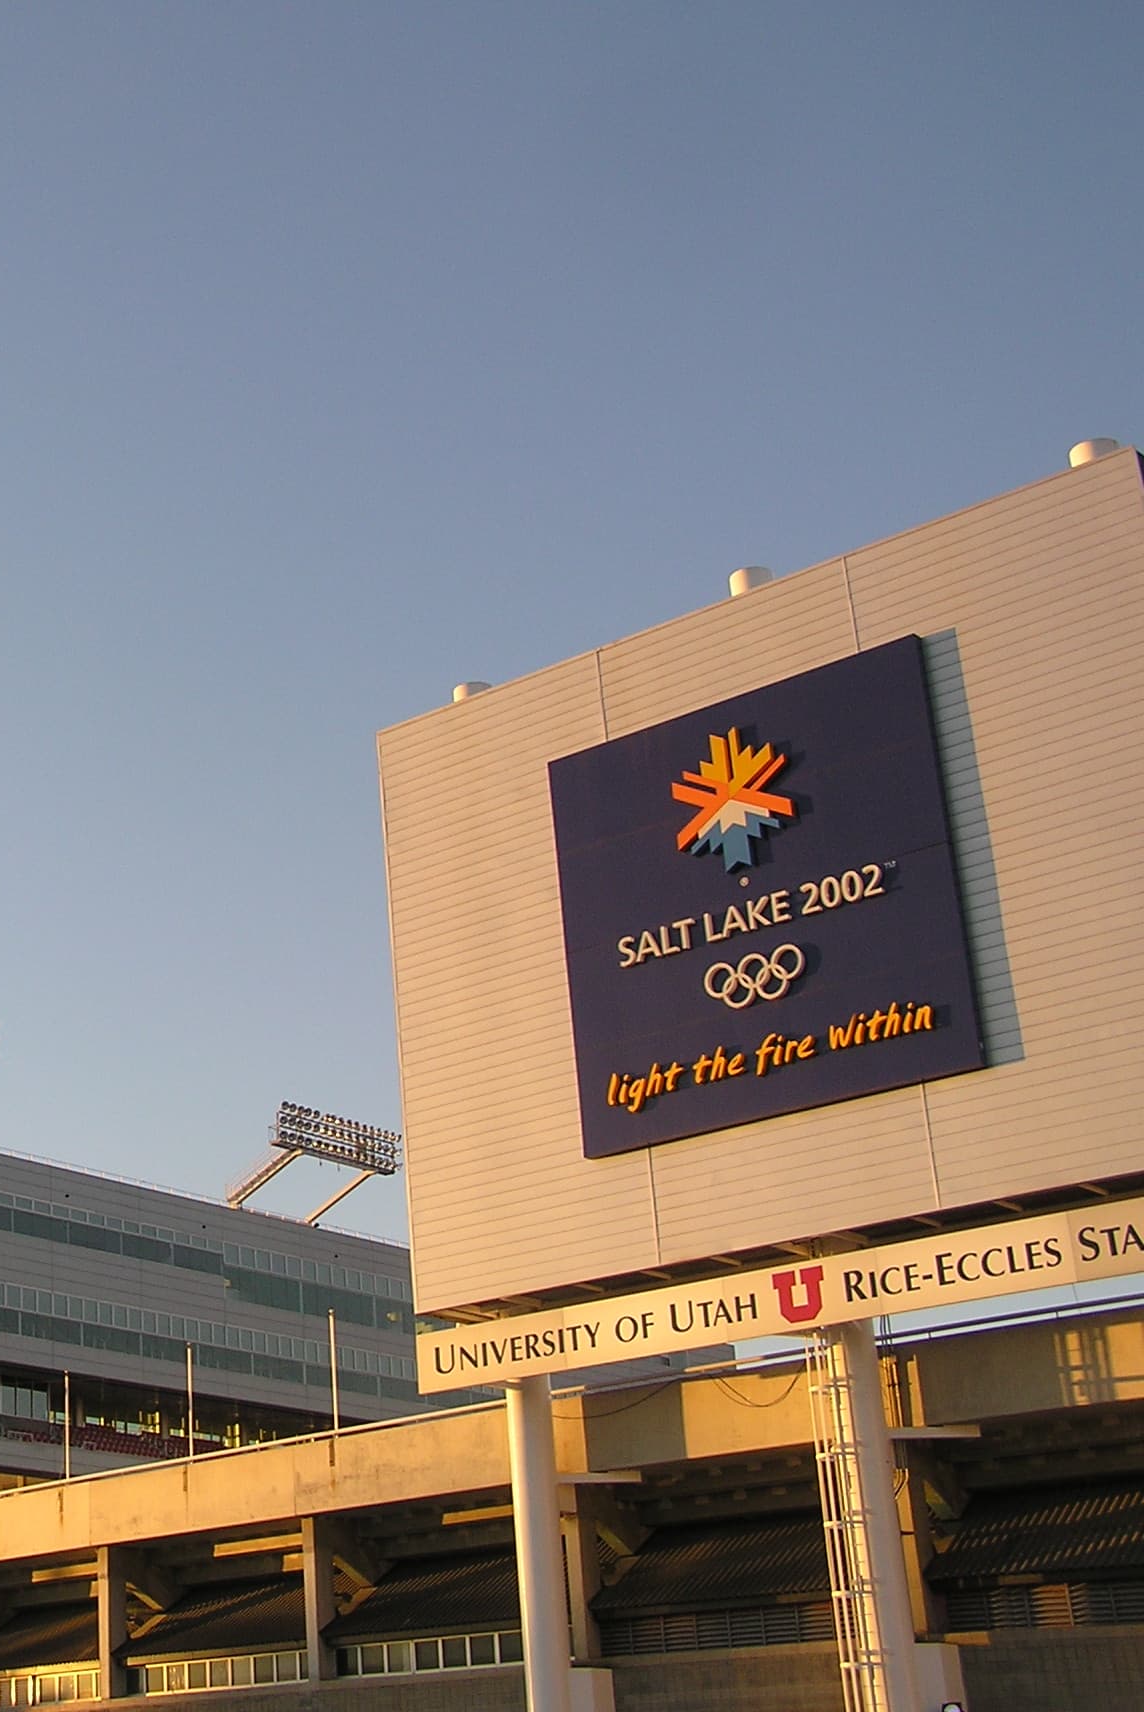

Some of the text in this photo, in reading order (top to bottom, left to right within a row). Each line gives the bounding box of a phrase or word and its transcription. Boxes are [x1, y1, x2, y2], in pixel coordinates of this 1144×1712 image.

[617, 917, 696, 968] SALT
[703, 890, 793, 943] LAKE
[800, 864, 886, 915] 2002
[607, 1061, 683, 1113] light
[691, 1045, 745, 1085] the
[755, 1032, 816, 1077] fire
[771, 1264, 825, 1325] U
[842, 1223, 1144, 1303] RICE-ECCLES STA
[433, 1292, 759, 1376] UNIVERSITY OF UTAH
